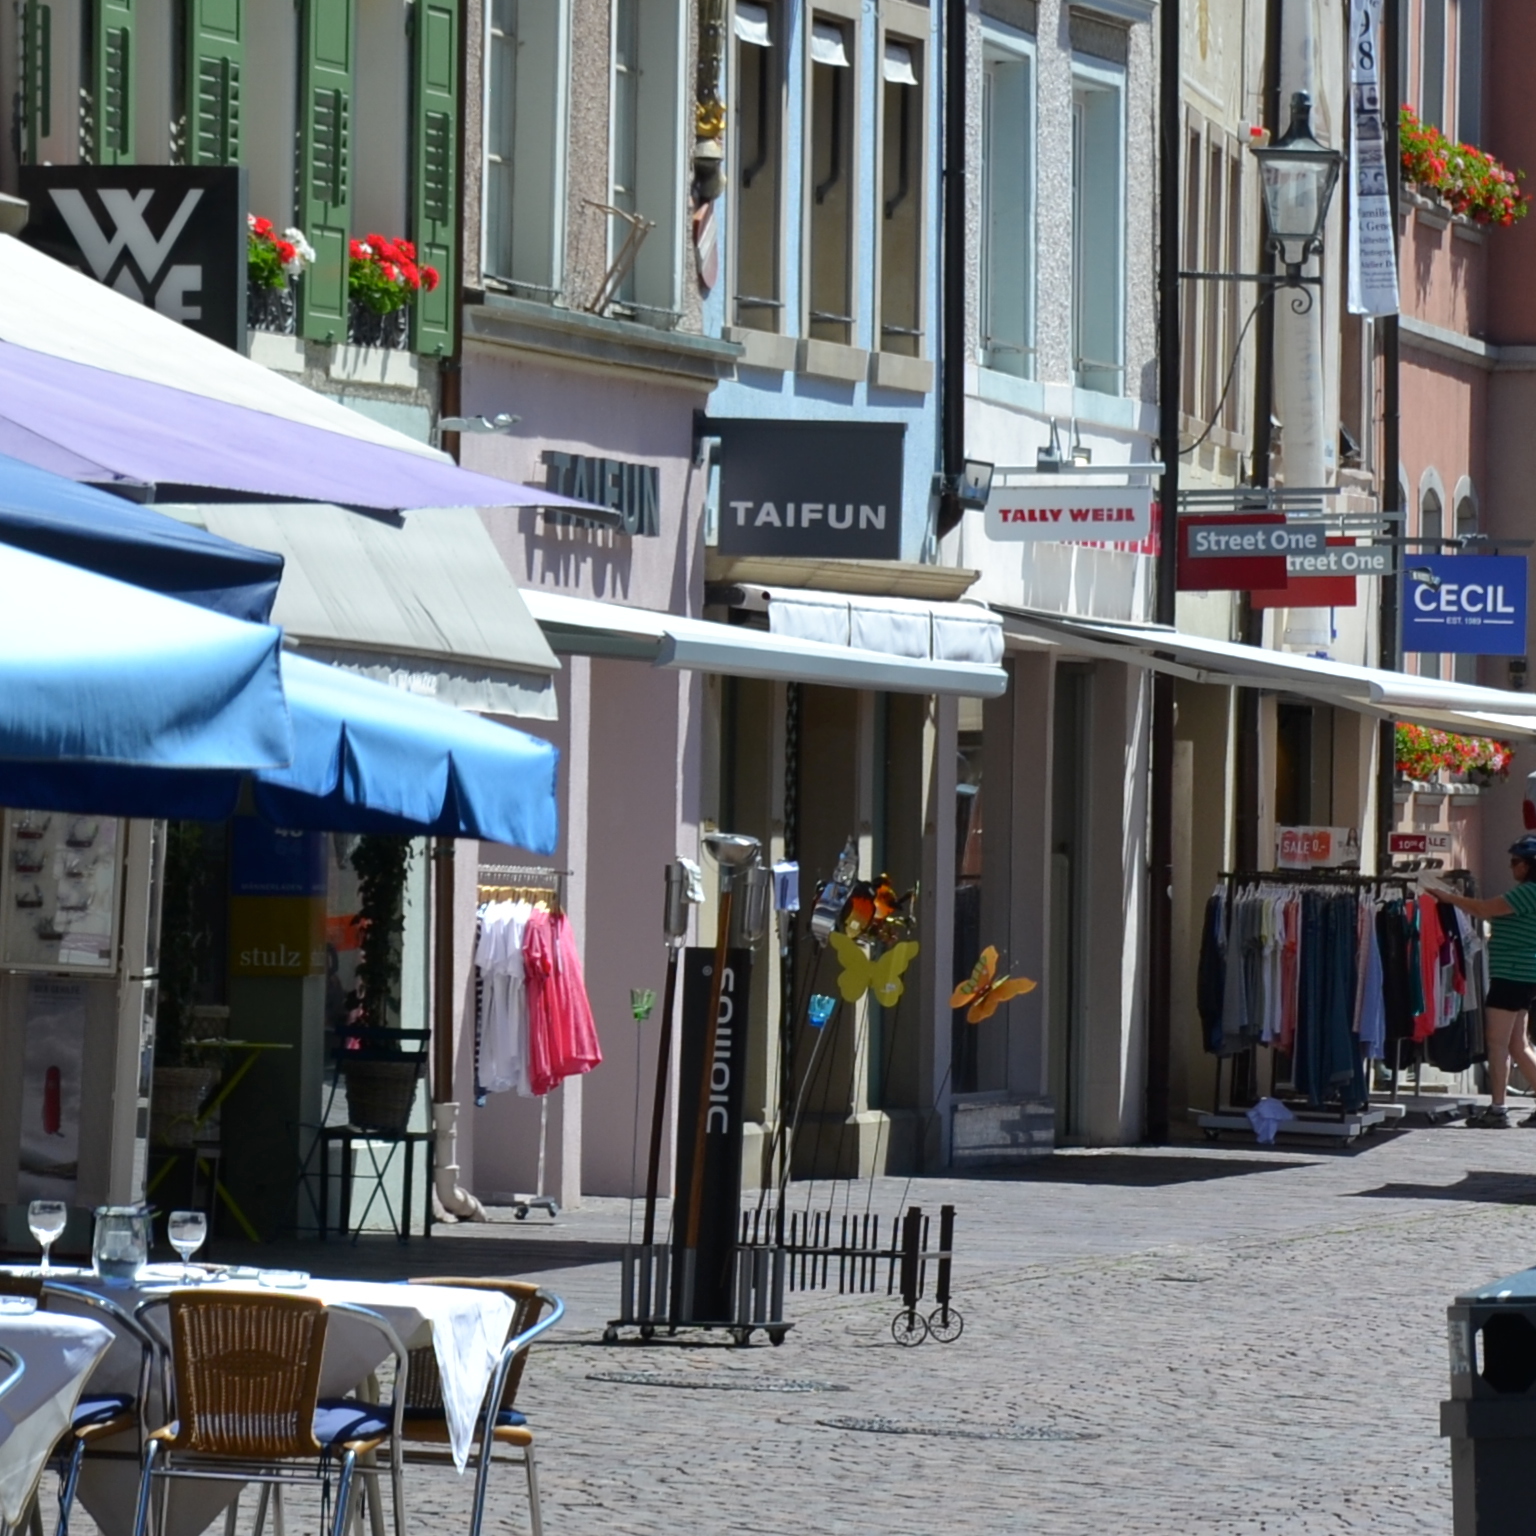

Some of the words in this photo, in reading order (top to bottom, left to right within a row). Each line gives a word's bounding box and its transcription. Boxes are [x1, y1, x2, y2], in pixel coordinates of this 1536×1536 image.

[729, 500, 886, 530] TAIFUN
[998, 508, 1062, 523] TALLY
[1196, 531, 1267, 551] Street
[1270, 529, 1318, 549] One
[1287, 552, 1338, 571] treet
[1341, 552, 1385, 570] One
[1414, 583, 1514, 614] CECIL
[1283, 840, 1310, 854] SALE
[240, 944, 301, 966] stulz
